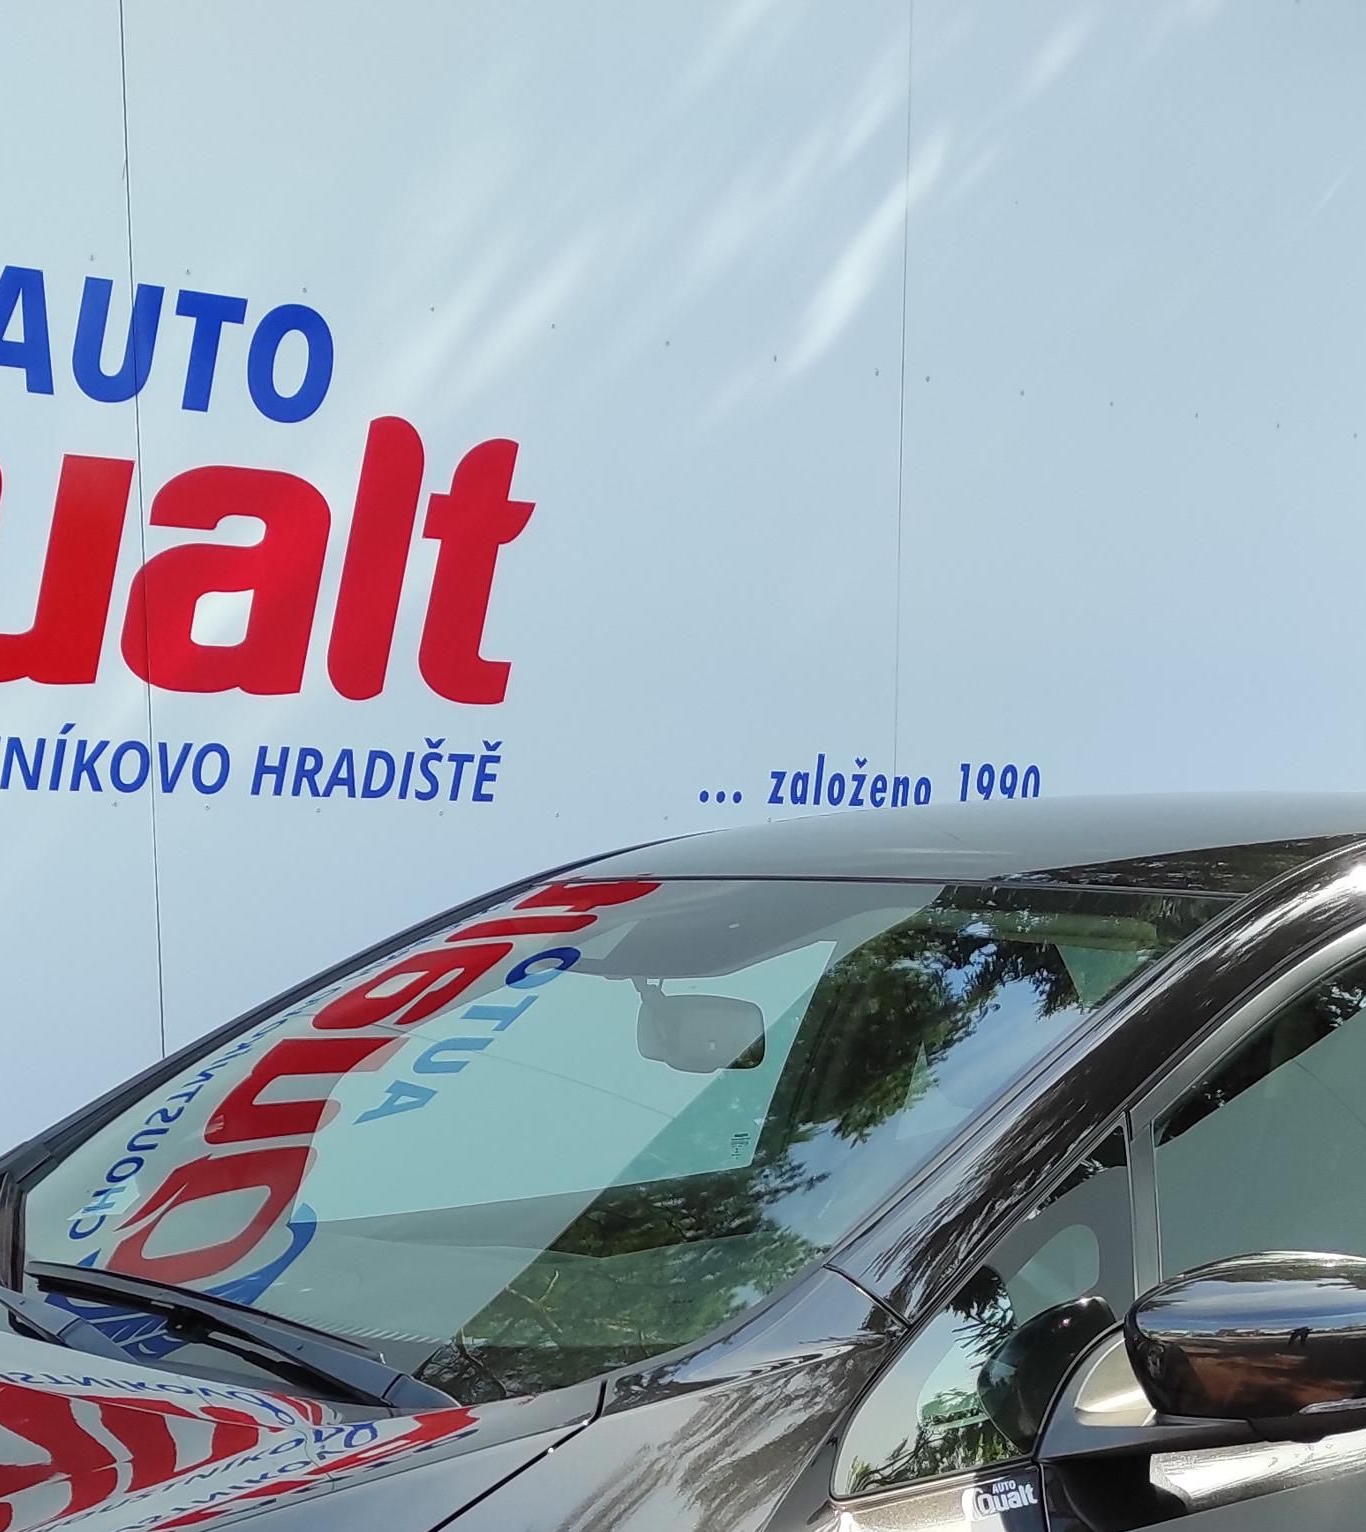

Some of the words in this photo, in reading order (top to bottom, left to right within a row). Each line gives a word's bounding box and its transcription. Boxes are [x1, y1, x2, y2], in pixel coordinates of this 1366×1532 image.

[249, 737, 503, 803] HRADIŠTĚ
[767, 753, 932, 808] založeno
[977, 1483, 1039, 1515] Qualt
[992, 1480, 1016, 1494] AUTO
